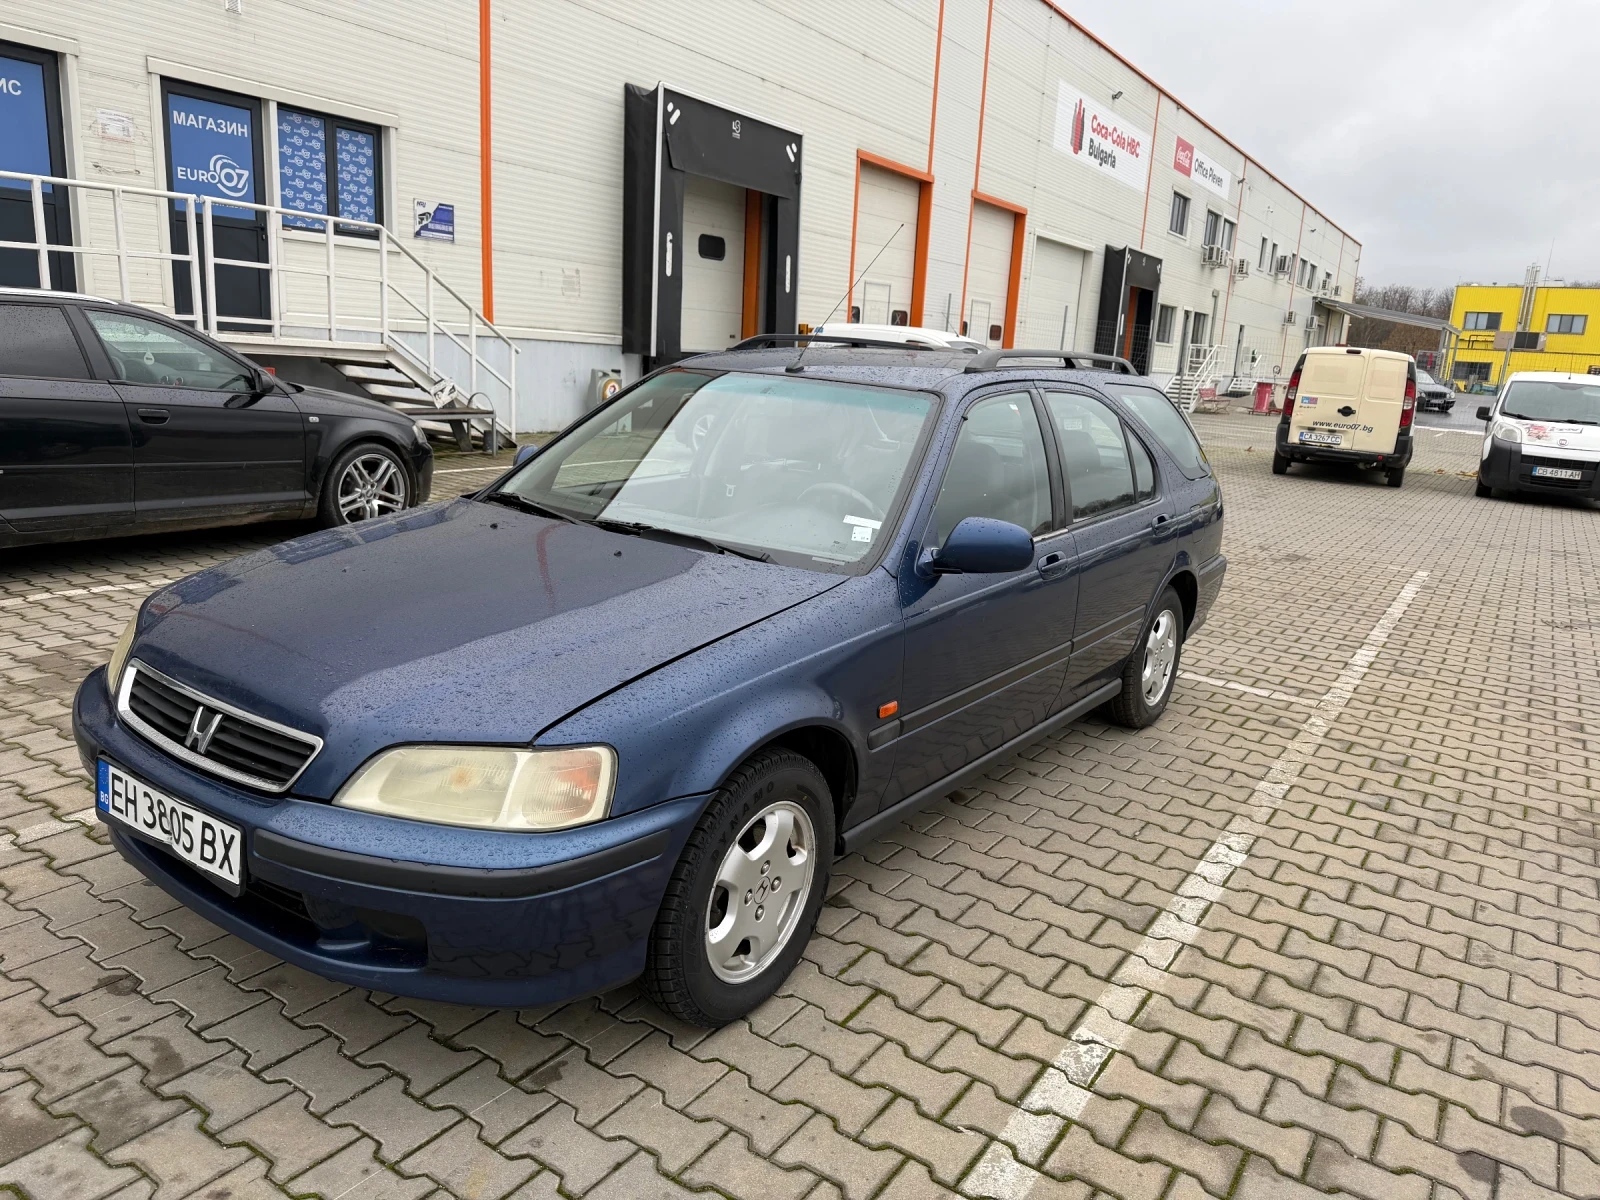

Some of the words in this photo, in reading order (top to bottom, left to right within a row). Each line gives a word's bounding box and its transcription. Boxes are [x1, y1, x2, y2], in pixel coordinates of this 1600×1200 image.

[173, 110, 248, 138] МАГАЗИН
[1091, 114, 1126, 151] Coca-Cola
[1125, 136, 1141, 159] HBC
[1088, 137, 1117, 169] Bulgaria
[1194, 158, 1209, 180] Office
[1208, 168, 1223, 188] Pleven
[1312, 420, 1374, 433] www.euro07.bg
[1313, 434, 1330, 442] 3267
[100, 791, 109, 805] BG
[111, 771, 138, 823] EH
[142, 790, 194, 855] 3805
[199, 820, 236, 876] BX
